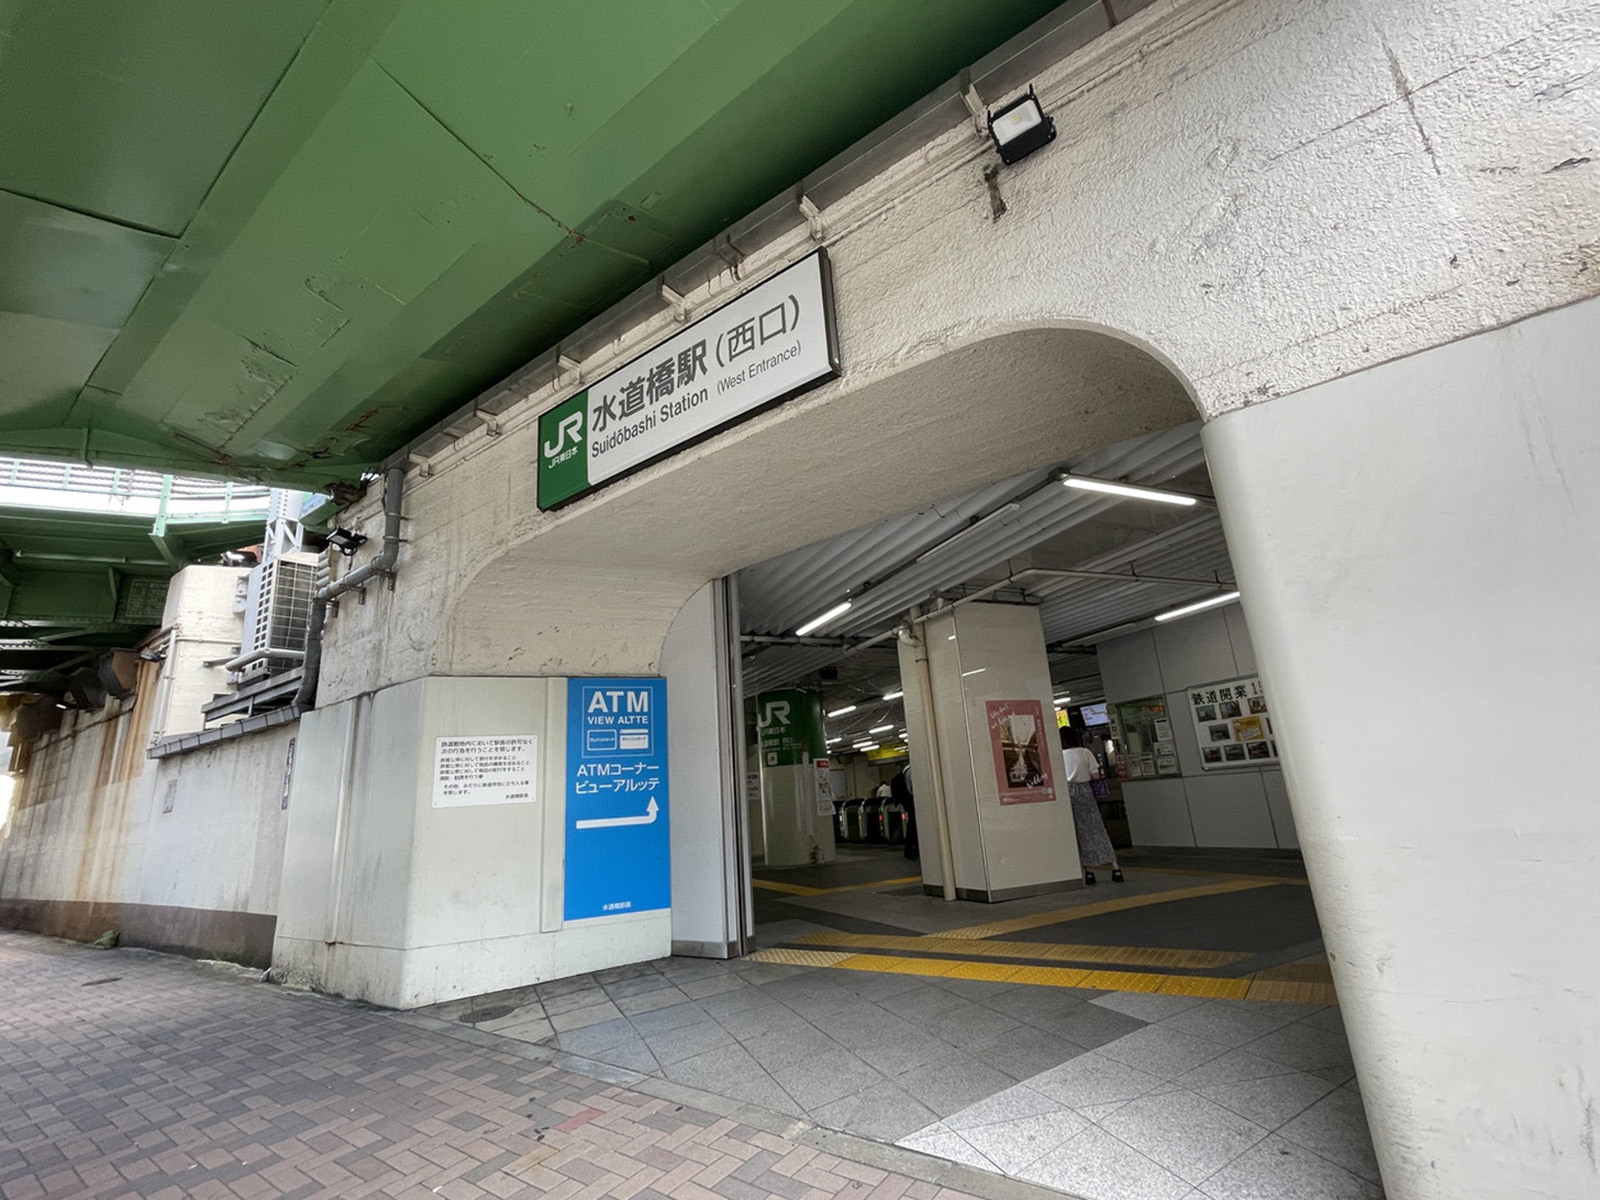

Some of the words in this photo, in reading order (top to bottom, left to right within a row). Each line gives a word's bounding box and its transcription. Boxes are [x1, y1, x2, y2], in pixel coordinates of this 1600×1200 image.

[591, 416, 657, 459] Suidōbashi
[660, 386, 709, 423] Station
[717, 371, 746, 396] (West
[748, 340, 802, 380] Entrance)
[544, 411, 584, 459] JR
[548, 446, 579, 469] JR東日本
[587, 691, 649, 713] ATM
[587, 716, 615, 725] VIEW
[617, 715, 649, 725] ALTTE
[758, 700, 791, 728] JR
[576, 761, 660, 777] ATMコーナー
[575, 777, 660, 794] ビューアルッテ
